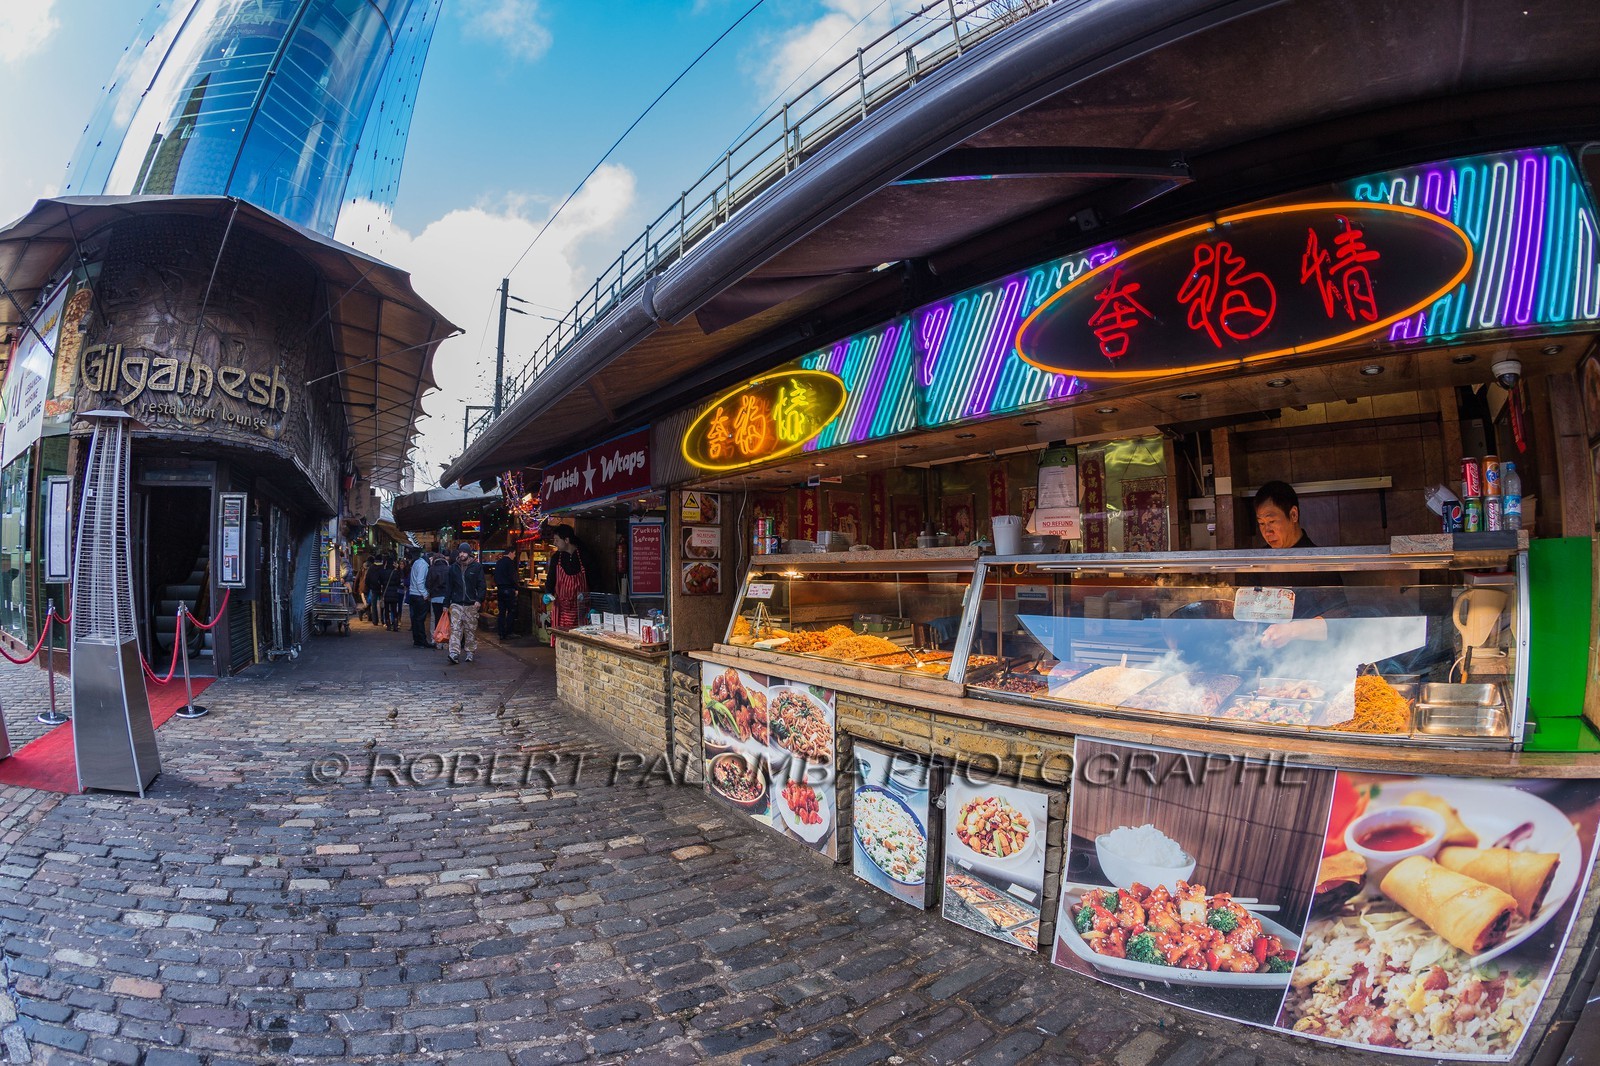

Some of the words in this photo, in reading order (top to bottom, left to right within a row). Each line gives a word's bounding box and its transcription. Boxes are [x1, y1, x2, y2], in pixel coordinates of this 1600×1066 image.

[81, 343, 291, 413] Gilgamesh
[142, 401, 215, 420] restaurant
[222, 409, 267, 430] lounge
[545, 466, 580, 500] Turkish
[600, 450, 646, 483] Wraps
